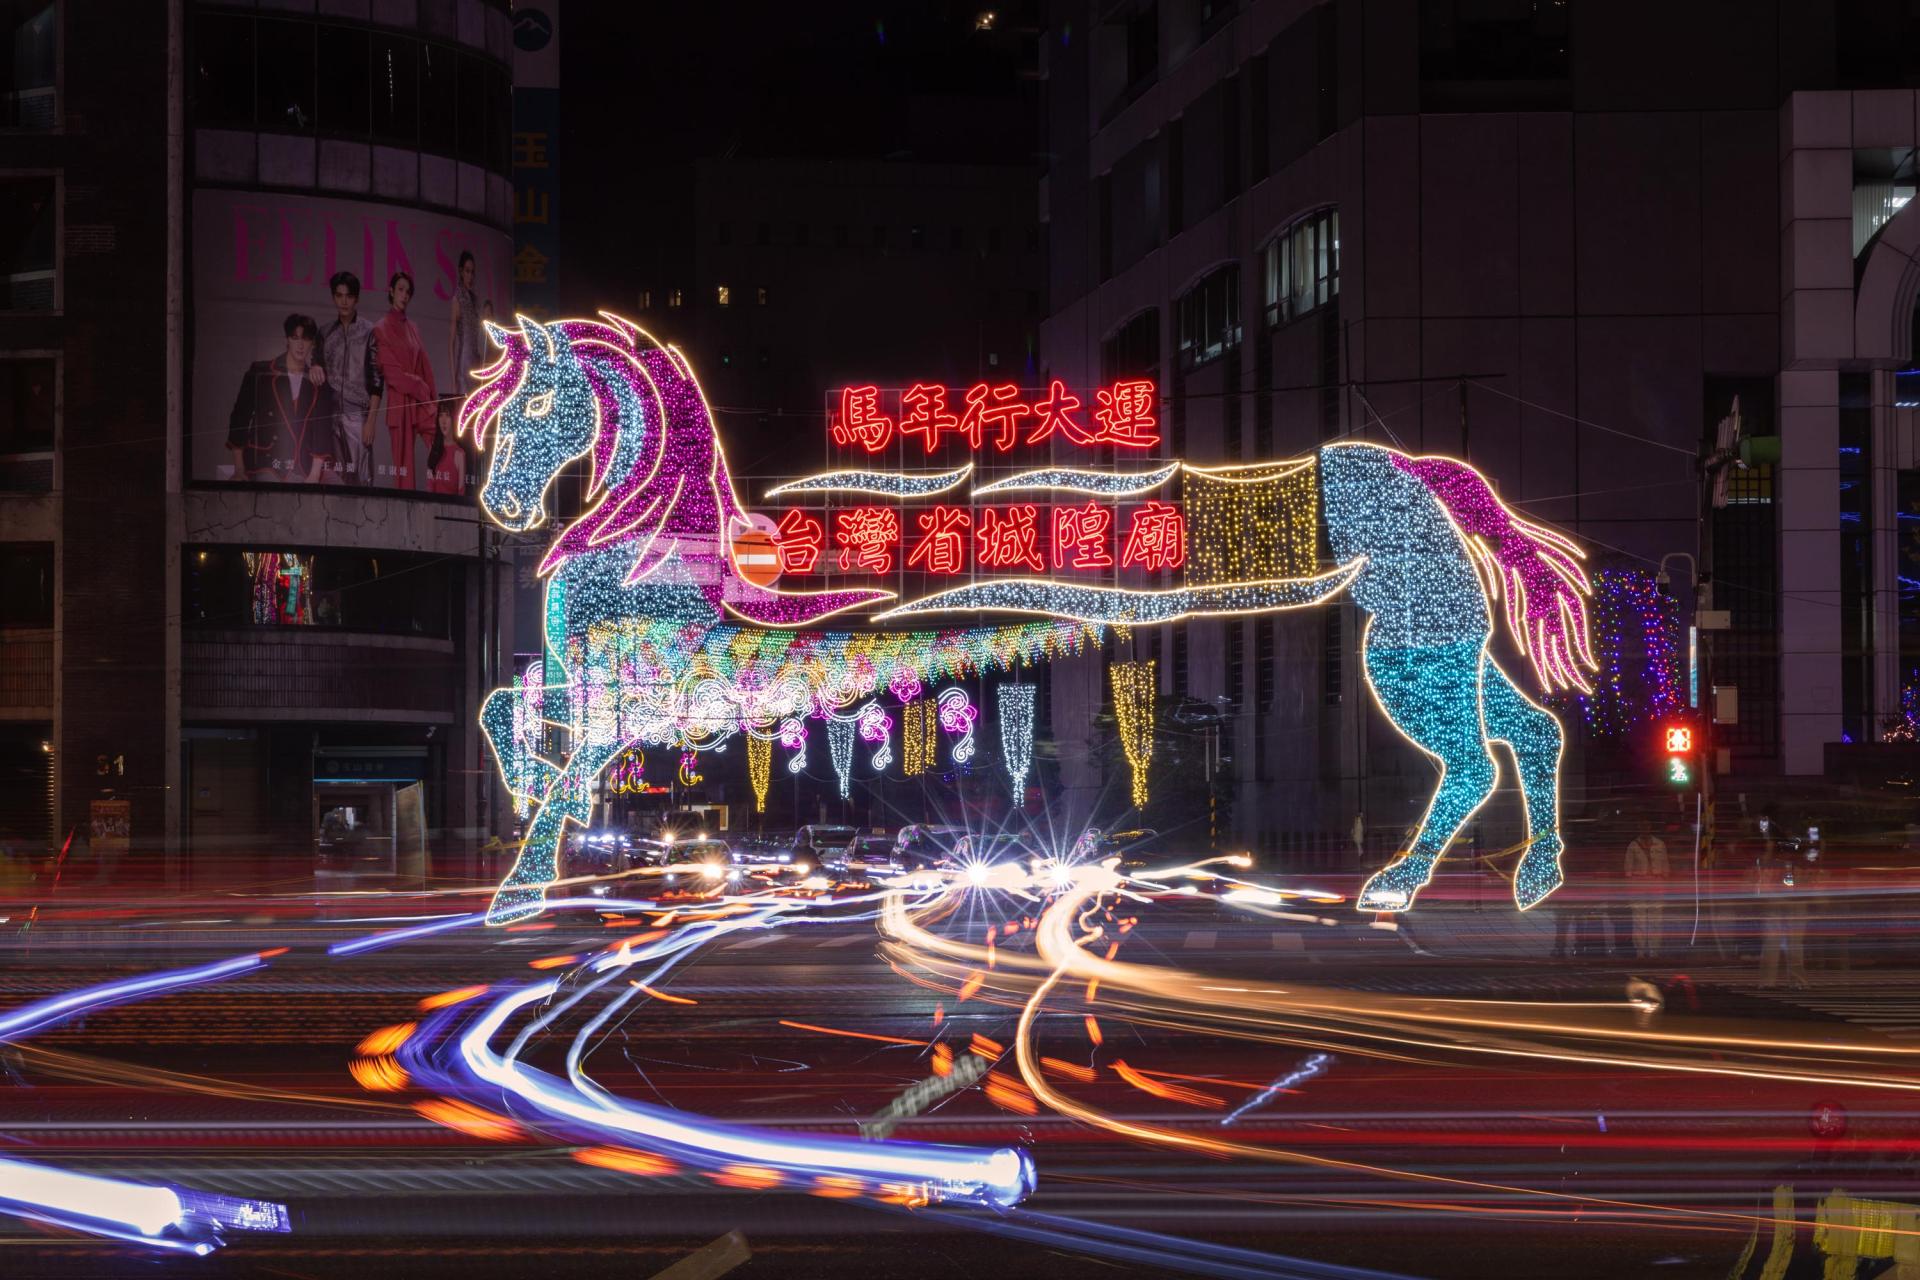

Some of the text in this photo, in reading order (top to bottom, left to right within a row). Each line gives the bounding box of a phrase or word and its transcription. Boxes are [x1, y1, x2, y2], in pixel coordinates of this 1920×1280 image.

[232, 205, 417, 293] EELIN
[833, 380, 1161, 453] 馬年行大運
[771, 500, 1186, 575] 台灣省城隍廟
